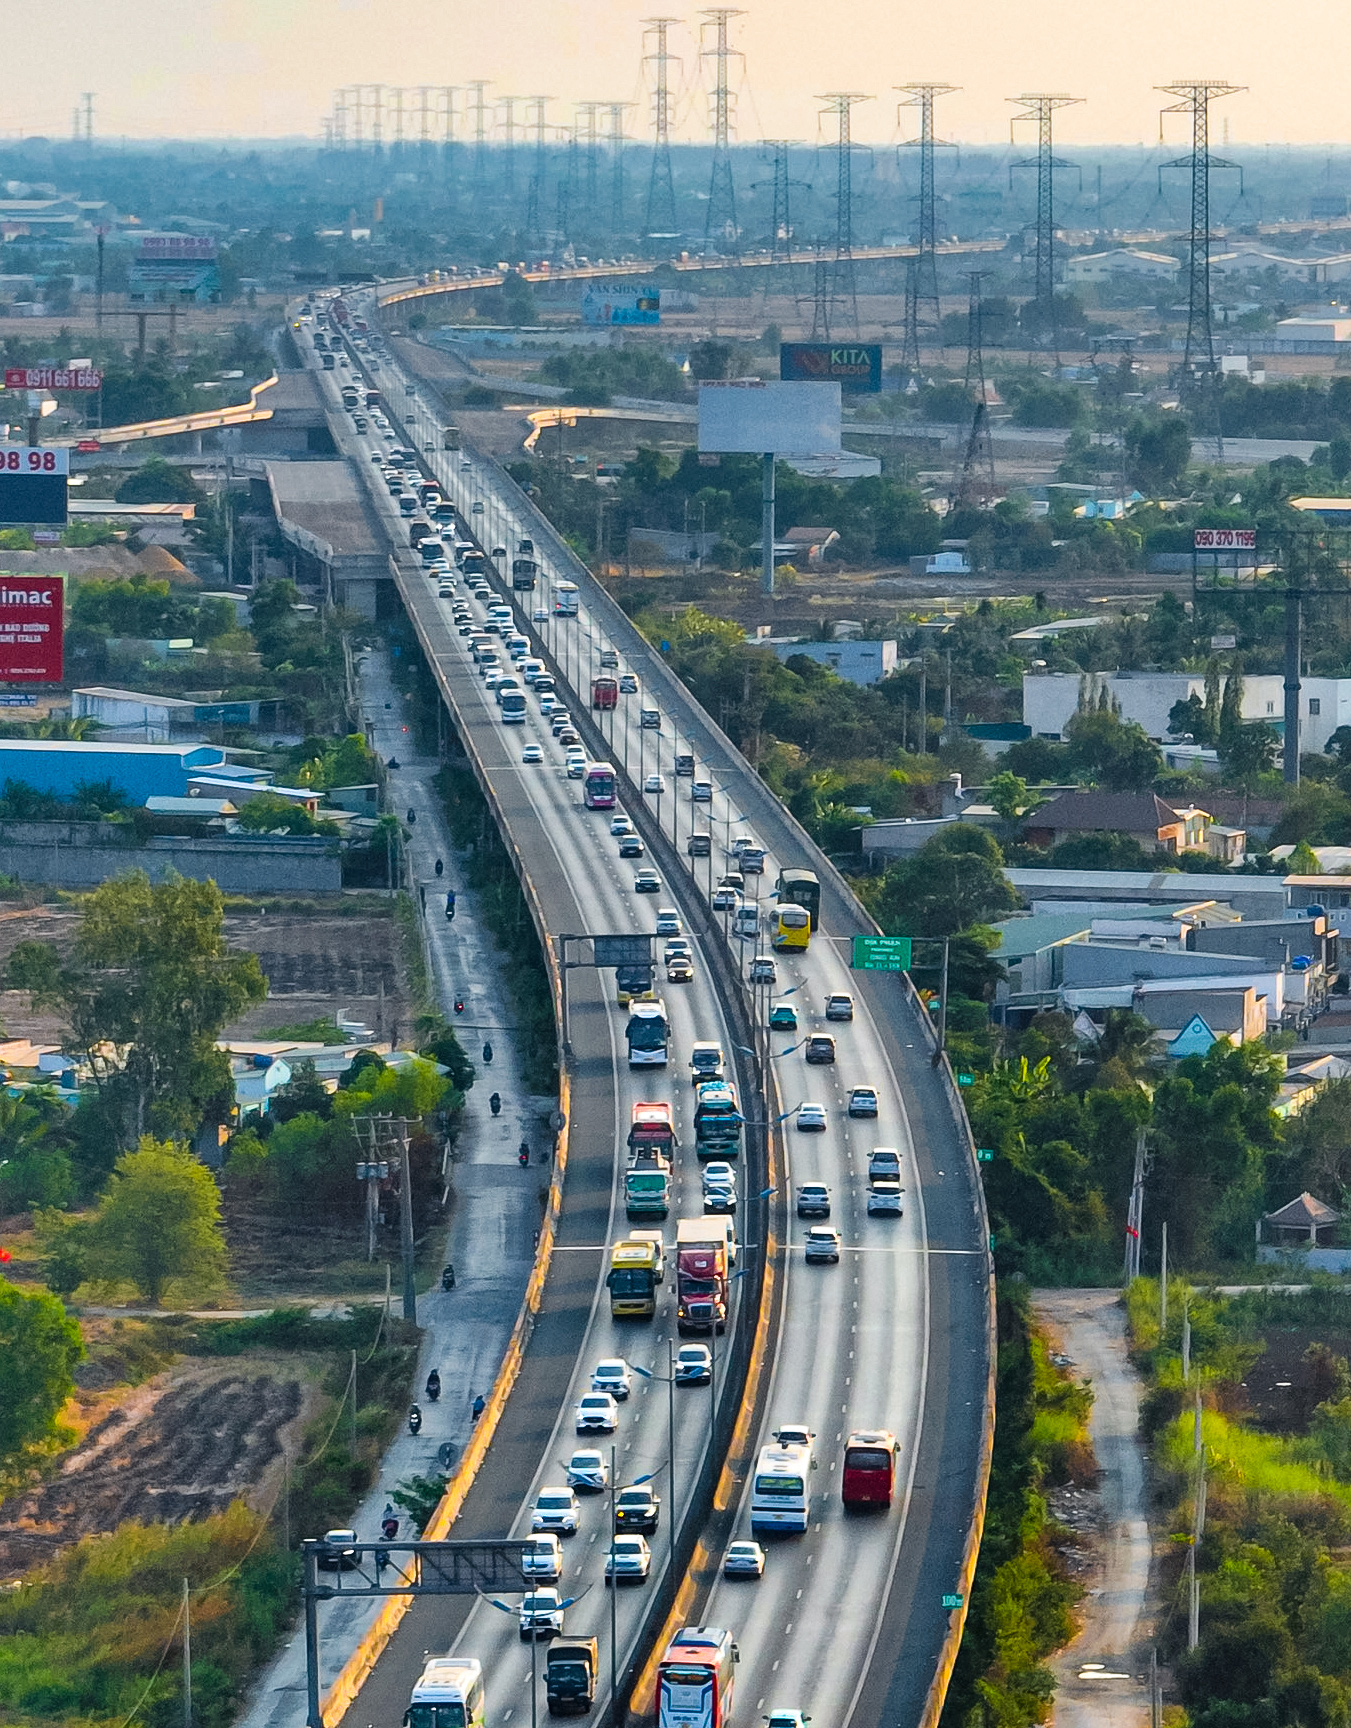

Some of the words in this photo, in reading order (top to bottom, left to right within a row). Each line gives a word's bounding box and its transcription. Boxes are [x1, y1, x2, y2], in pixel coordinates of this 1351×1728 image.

[831, 350, 871, 365] KITA
[28, 452, 55, 471] 98
[1196, 531, 1213, 546] 090
[1216, 531, 1233, 546] 370
